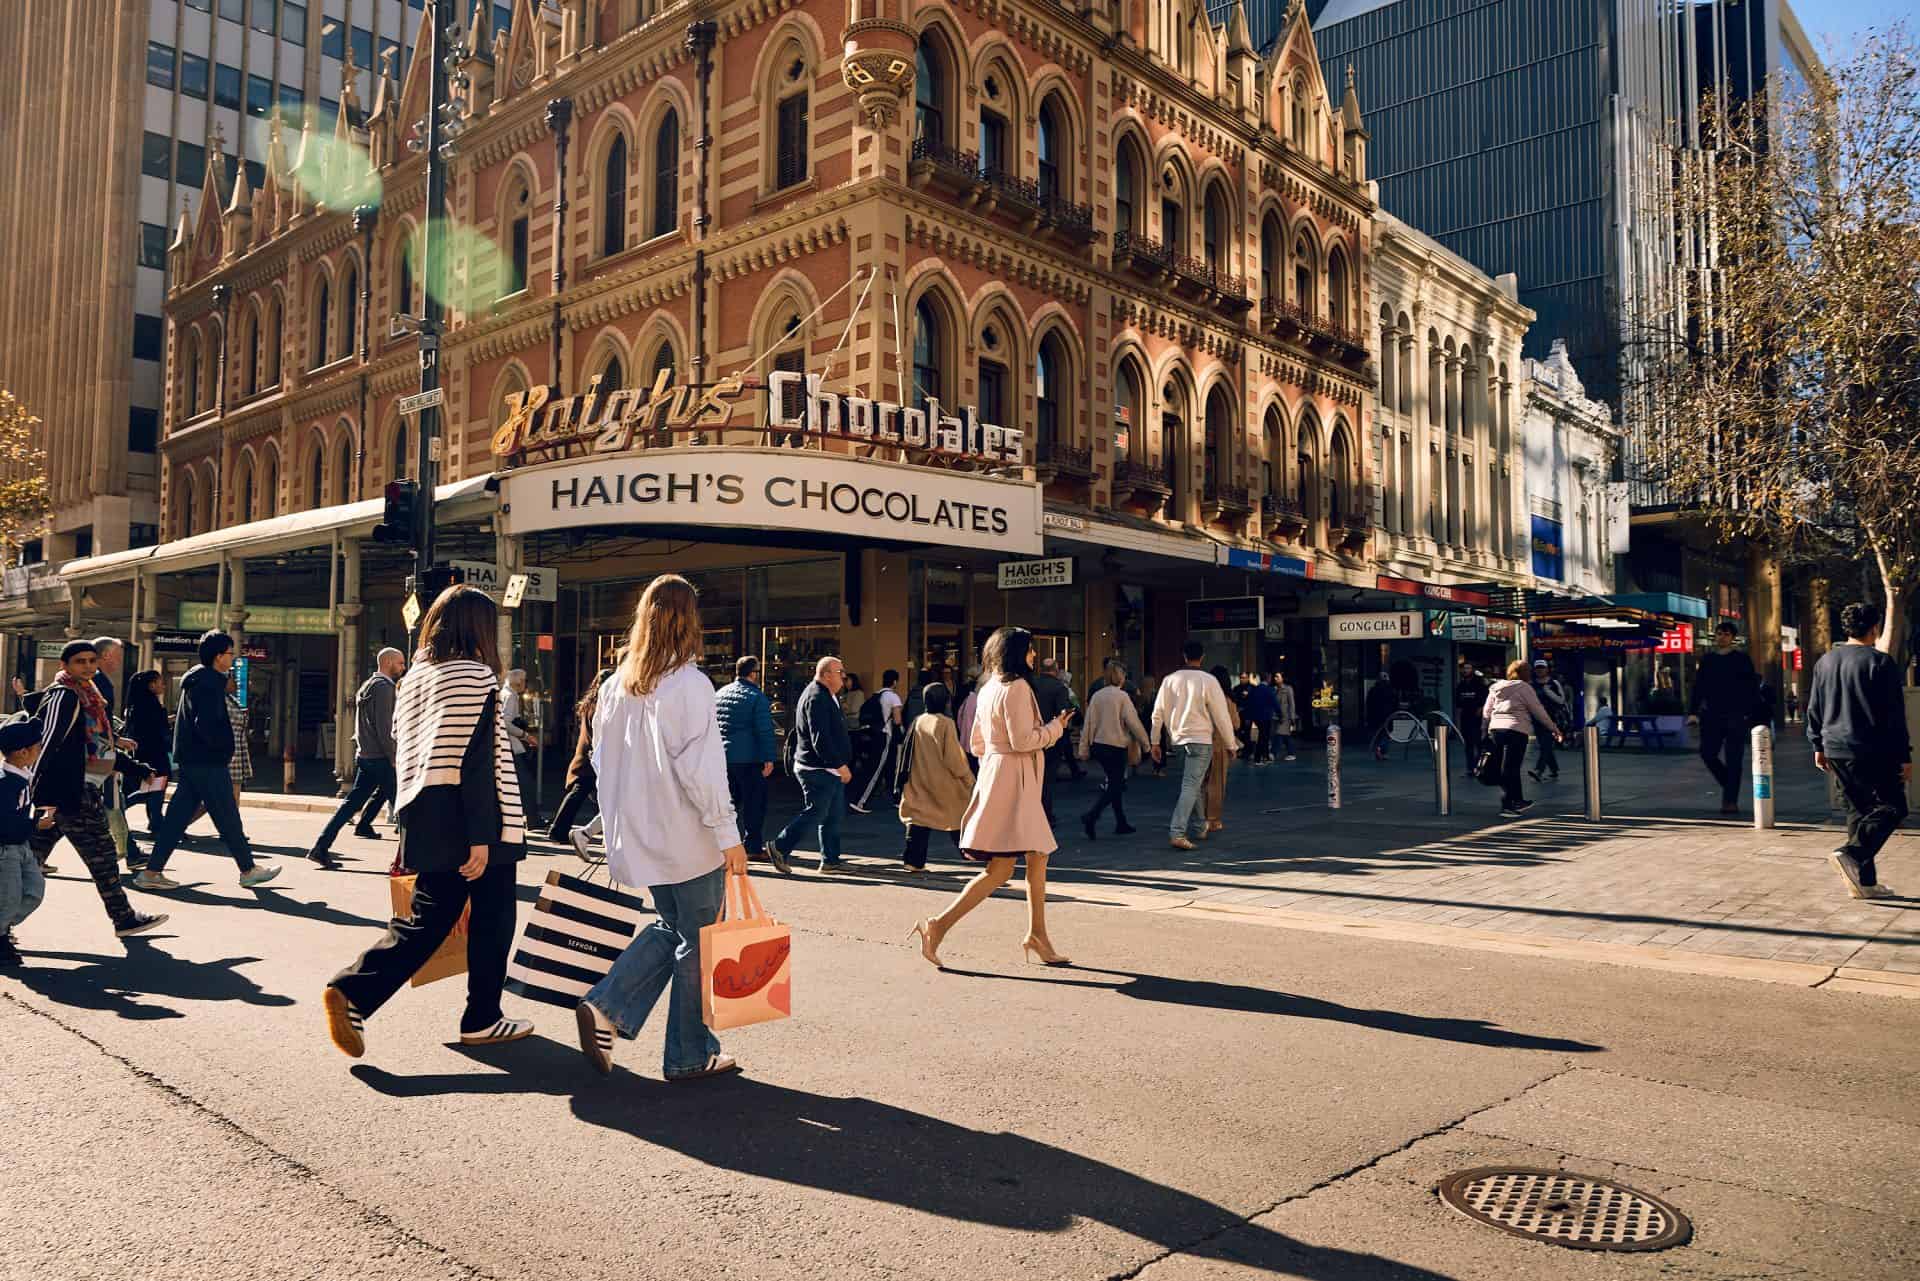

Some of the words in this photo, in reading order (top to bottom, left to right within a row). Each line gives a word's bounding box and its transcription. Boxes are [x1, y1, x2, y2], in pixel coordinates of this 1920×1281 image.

[768, 370, 1025, 464] Chocolates
[551, 472, 746, 511] HAIGH'S
[764, 476, 1009, 535] CHOCOLATES
[1005, 561, 1066, 578] HAIGH'S
[1004, 575, 1065, 586] CHOCOLATES
[1340, 620, 1372, 632] GONG
[1374, 620, 1397, 631] CHA
[568, 939, 598, 953] SEPHORA
